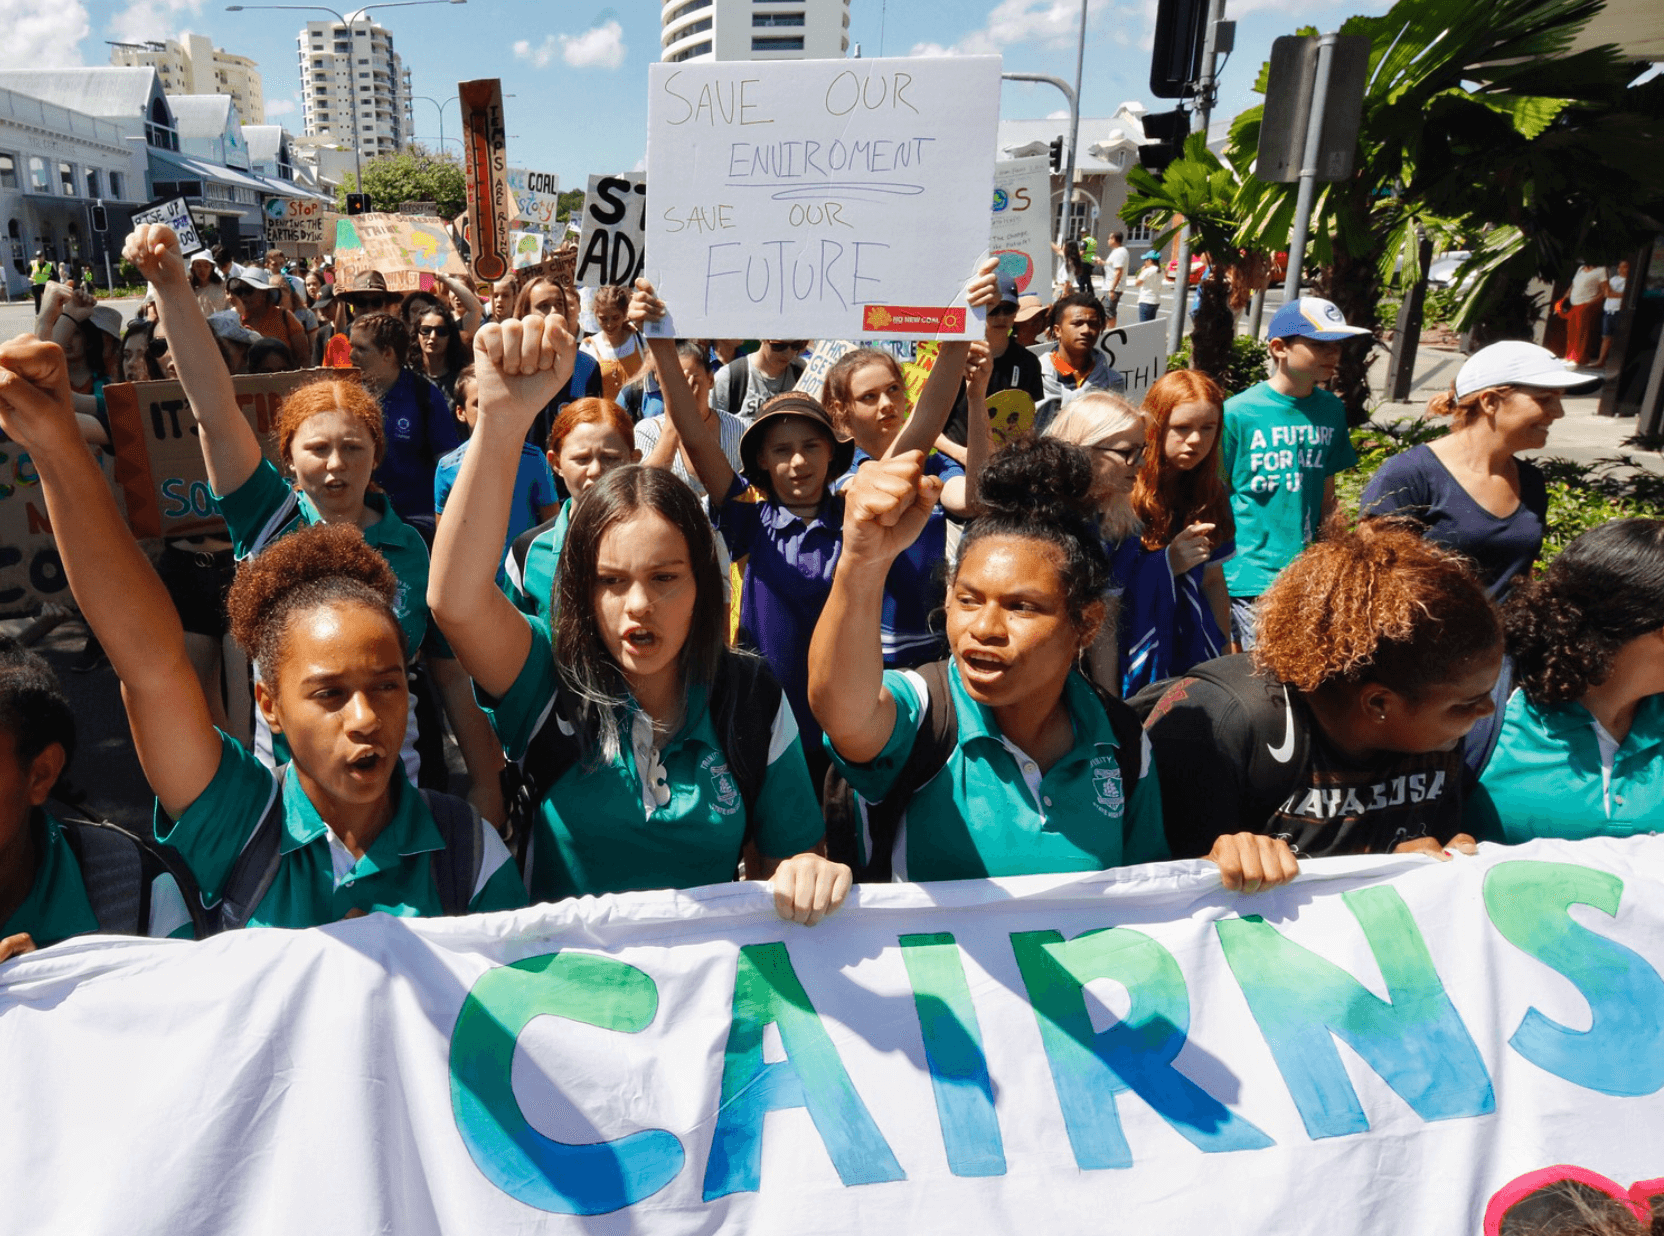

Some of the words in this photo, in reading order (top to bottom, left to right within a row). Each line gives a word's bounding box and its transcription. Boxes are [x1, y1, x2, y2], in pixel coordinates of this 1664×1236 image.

[665, 70, 775, 126] SAVE
[825, 70, 920, 116] OUR
[728, 137, 937, 178] ENVIROMENT
[527, 171, 557, 195] COAL
[306, 217, 323, 231] THE
[664, 204, 737, 234] SAVE
[788, 202, 854, 229] OUR
[704, 239, 891, 315] FUTURE
[893, 315, 904, 324] NO
[904, 316, 921, 324] NEW
[921, 316, 940, 324] COAL
[1119, 355, 1158, 391] TH!
[1250, 429, 1268, 450] A
[1250, 449, 1294, 472] FOR
[1297, 448, 1324, 469] ALL
[1250, 473, 1281, 494] OF
[1285, 471, 1304, 493] U
[448, 859, 1664, 1217] CAIRNS
